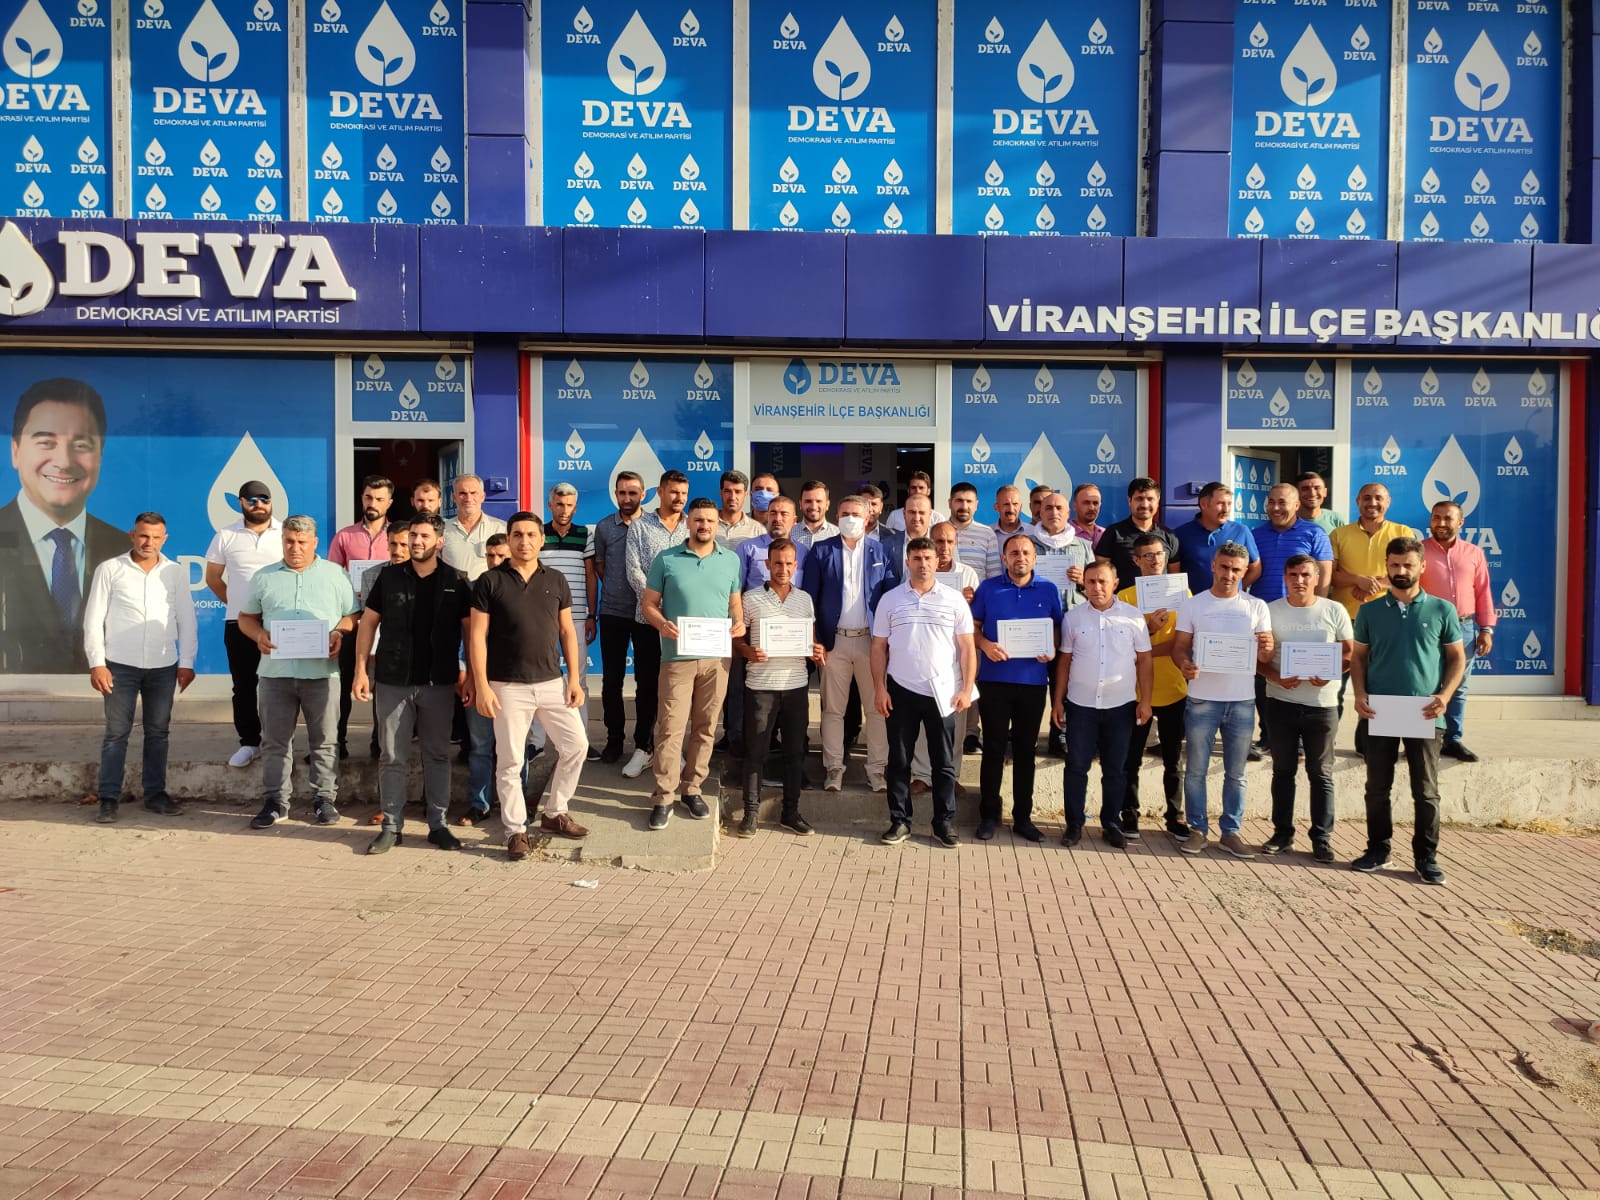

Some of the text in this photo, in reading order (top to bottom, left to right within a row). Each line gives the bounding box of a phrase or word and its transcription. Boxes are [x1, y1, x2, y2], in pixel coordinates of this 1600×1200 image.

[1417, 1, 1449, 11] DEVA
[1468, 2, 1499, 12] DEVA
[1517, 4, 1548, 14] DEVA
[70, 17, 105, 28] DEVA
[137, 19, 172, 30] DEVA
[246, 21, 281, 32] DEVA
[313, 23, 349, 33] DEVA
[423, 26, 457, 36] DEVA
[567, 33, 601, 45] DEVA
[673, 36, 707, 48] DEVA
[773, 39, 806, 50] DEVA
[877, 42, 911, 53] DEVA
[978, 44, 1011, 54] DEVA
[1081, 45, 1114, 55] DEVA
[1242, 48, 1275, 58] DEVA
[1344, 51, 1376, 61] DEVA
[1417, 54, 1449, 64] DEVA
[1516, 57, 1548, 66] DEVA
[0, 84, 90, 110] EVA
[153, 87, 266, 115] DEVA
[330, 91, 442, 119] DEVA
[582, 100, 692, 128] DEVA
[788, 105, 895, 133] DEVA
[992, 109, 1099, 135] DEVA
[1255, 111, 1360, 138] DEVA
[1430, 116, 1533, 143] DEVA
[16, 163, 52, 173] DEVA
[71, 164, 106, 174] DEVA
[138, 166, 174, 176] DEVA
[193, 167, 228, 177] DEVA
[248, 168, 283, 178] DEVA
[314, 170, 350, 180] DEVA
[369, 171, 404, 182] DEVA
[424, 173, 458, 183] DEVA
[567, 179, 601, 189] DEVA
[620, 180, 654, 190] DEVA
[673, 181, 707, 191] DEVA
[772, 183, 806, 193] DEVA
[824, 184, 858, 194] DEVA
[876, 185, 910, 195] DEVA
[977, 187, 1011, 196] DEVA
[1029, 187, 1062, 197] DEVA
[1080, 188, 1113, 197] DEVA
[1238, 190, 1272, 199] DEVA
[1289, 191, 1323, 200] DEVA
[1340, 192, 1373, 201] DEVA
[1414, 194, 1447, 203] DEVA
[1464, 195, 1496, 204] DEVA
[1514, 196, 1546, 205] DEVA
[16, 208, 52, 218] DEVA
[72, 209, 106, 219] DEVA
[138, 211, 173, 220] DEVA
[193, 212, 228, 220] DEVA
[248, 213, 283, 221] DEVA
[58, 231, 356, 301] DEVA
[76, 304, 340, 323] DEMOKRASİ VE ATILIM PARTİSİ
[988, 298, 1262, 341] VİRANŞEHİR
[1270, 301, 1366, 343] İLÇE
[818, 362, 900, 385] DEVA
[356, 381, 393, 391] DEVA
[428, 382, 464, 392] DEVA
[558, 389, 592, 399] DEVA
[623, 389, 656, 400] DEVA
[687, 390, 720, 401] DEVA
[965, 393, 998, 404] DEVA
[1027, 394, 1061, 404] DEVA
[1090, 394, 1122, 404] DEVA
[1229, 389, 1264, 399] DEVA
[1297, 389, 1332, 400] DEVA
[1356, 396, 1389, 406] DEVA
[1413, 396, 1446, 407] DEVA
[1465, 396, 1497, 407] DEVA
[1521, 397, 1552, 407] DEVA
[391, 411, 428, 421] DEVA
[753, 403, 930, 419] VİRANŞEHİR İLÇE BAŞKANLIĞI
[1262, 418, 1296, 428] DEVA
[558, 460, 592, 470] DEVA
[687, 461, 721, 471] DEVA
[964, 463, 998, 474] DEVA
[1089, 463, 1122, 474] DEVA
[1374, 465, 1407, 475] DEVA
[1497, 466, 1529, 476] DEVA
[1495, 608, 1526, 618] DEVA
[1471, 660, 1492, 670] EVA
[1515, 660, 1547, 670] DEVA
